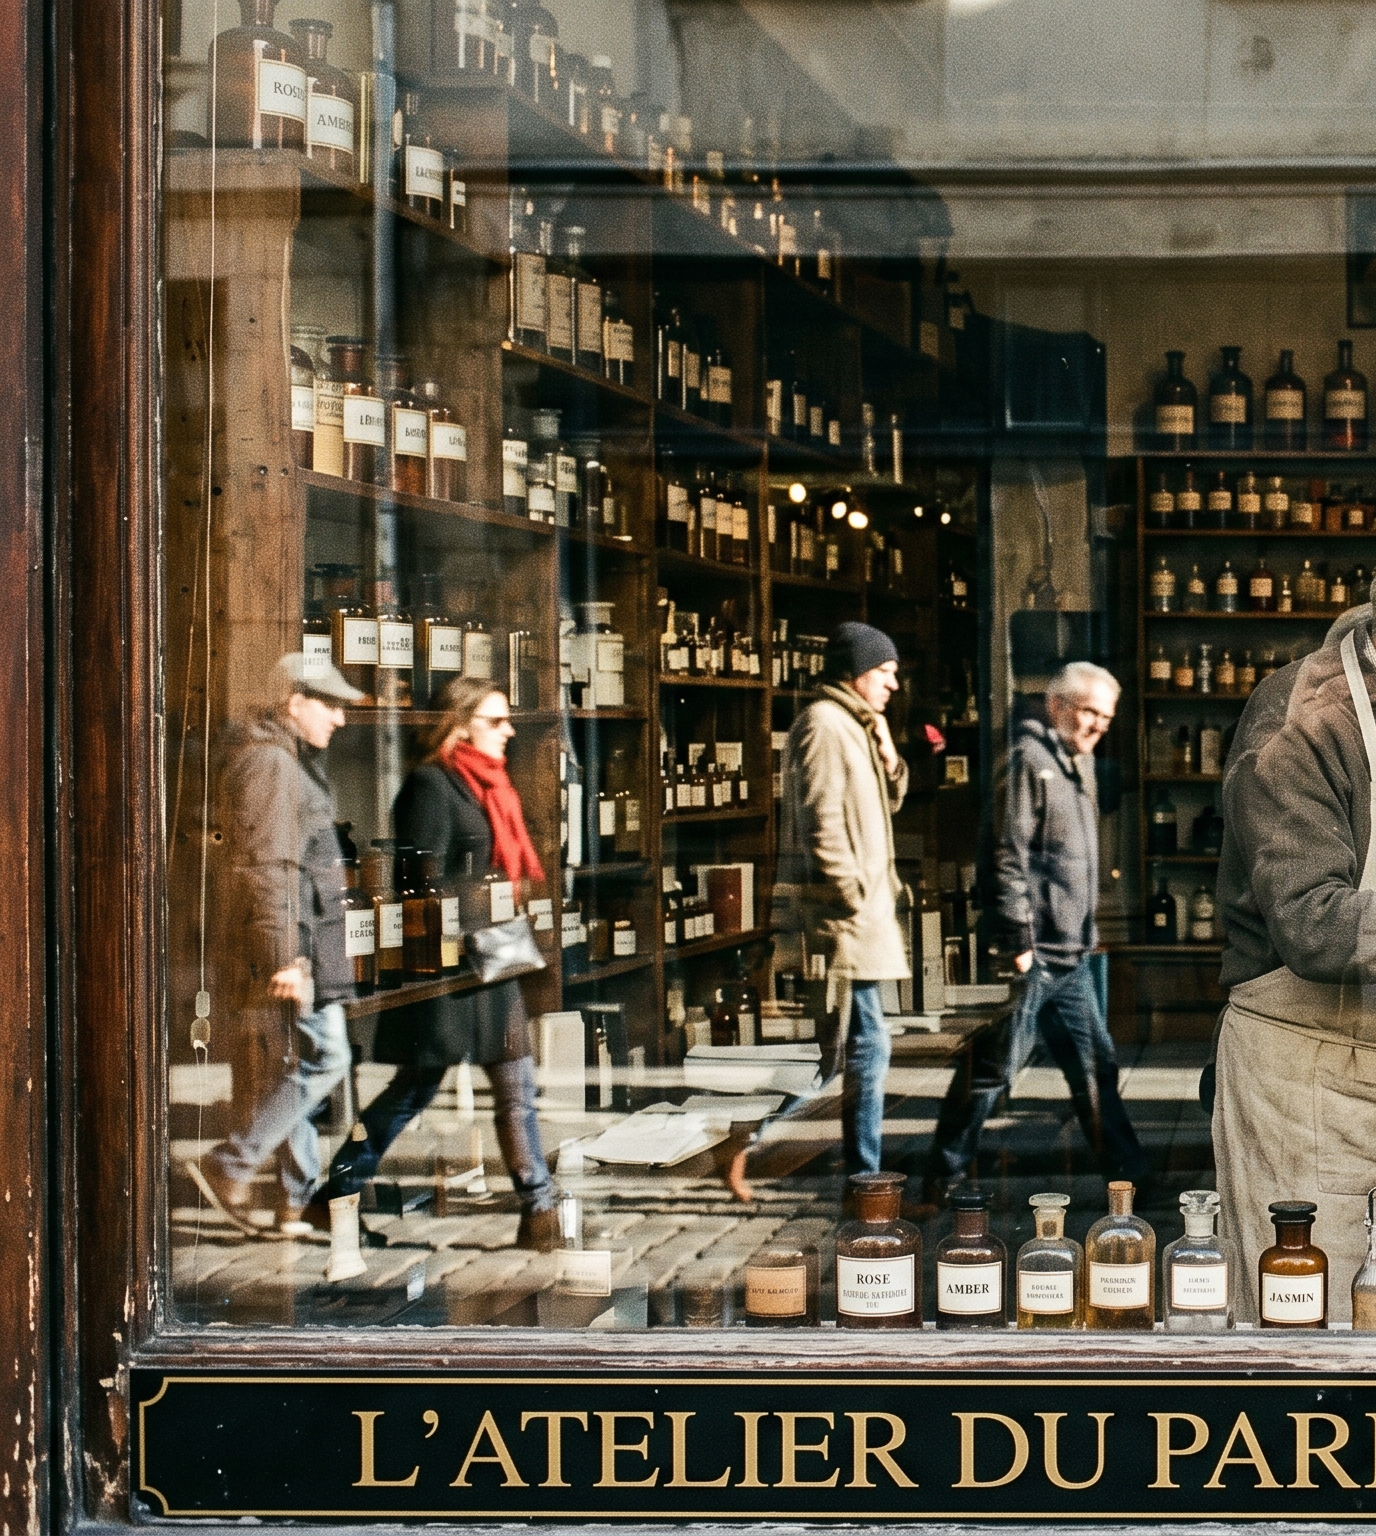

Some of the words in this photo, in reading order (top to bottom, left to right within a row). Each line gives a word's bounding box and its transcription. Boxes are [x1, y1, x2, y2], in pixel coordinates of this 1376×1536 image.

[856, 1273, 890, 1285] ROSE
[945, 1283, 990, 1295] AMBER
[1269, 1292, 1315, 1304] JASMIN
[352, 1409, 919, 1488] L'ATELIER
[951, 1411, 1115, 1490] DU
